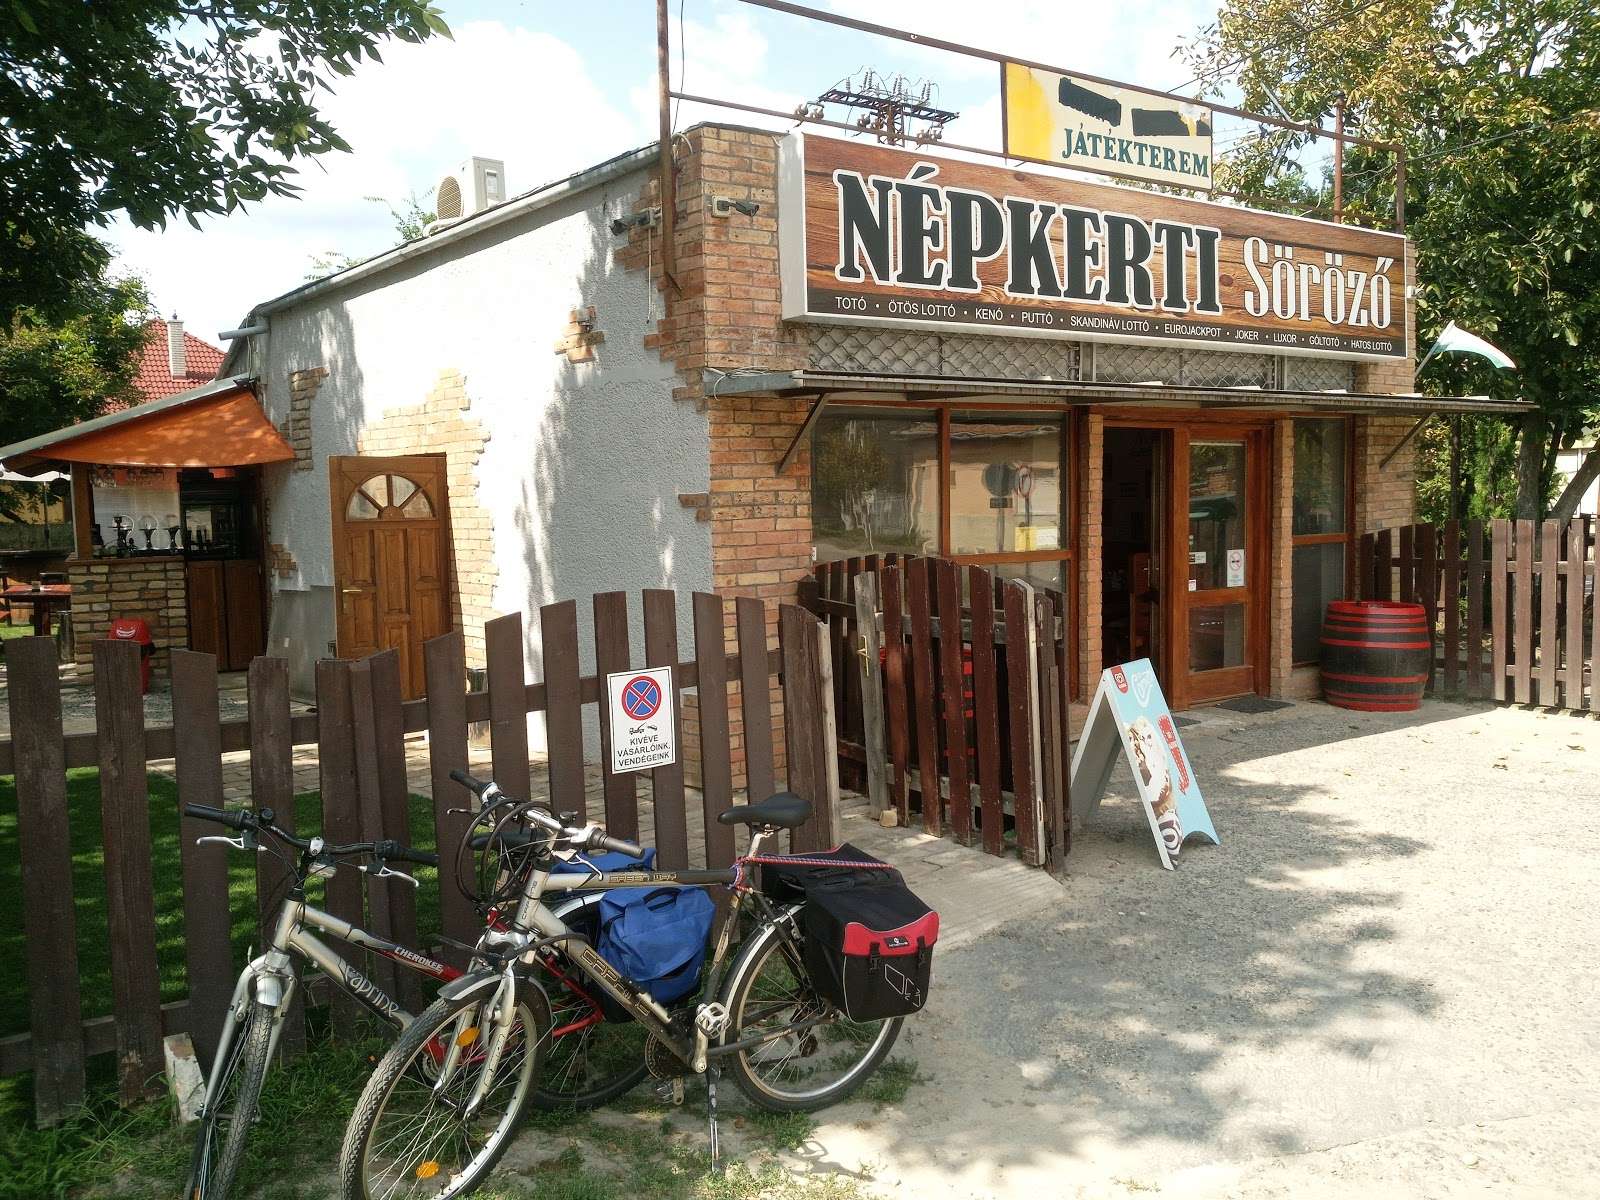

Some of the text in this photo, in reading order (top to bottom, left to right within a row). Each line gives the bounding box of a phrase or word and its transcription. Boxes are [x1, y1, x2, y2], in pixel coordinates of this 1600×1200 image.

[1062, 123, 1210, 178] JÁTÉKTEREM
[833, 161, 1222, 315] NÉPKERTI
[1243, 236, 1394, 329] Söröző
[835, 296, 1393, 352] TOTÓ ÖTÖS LOTTÓ KENÓ PUTTÓ SKANDINÁV LOTTÓ EUROJACKPOT JOKER LUXOR GÓLTOTÓ HATOS LOTTÓ
[618, 751, 670, 767] VENDÉGEINK
[630, 734, 659, 746] KIVÉVE
[394, 946, 444, 971] CHEROKEE
